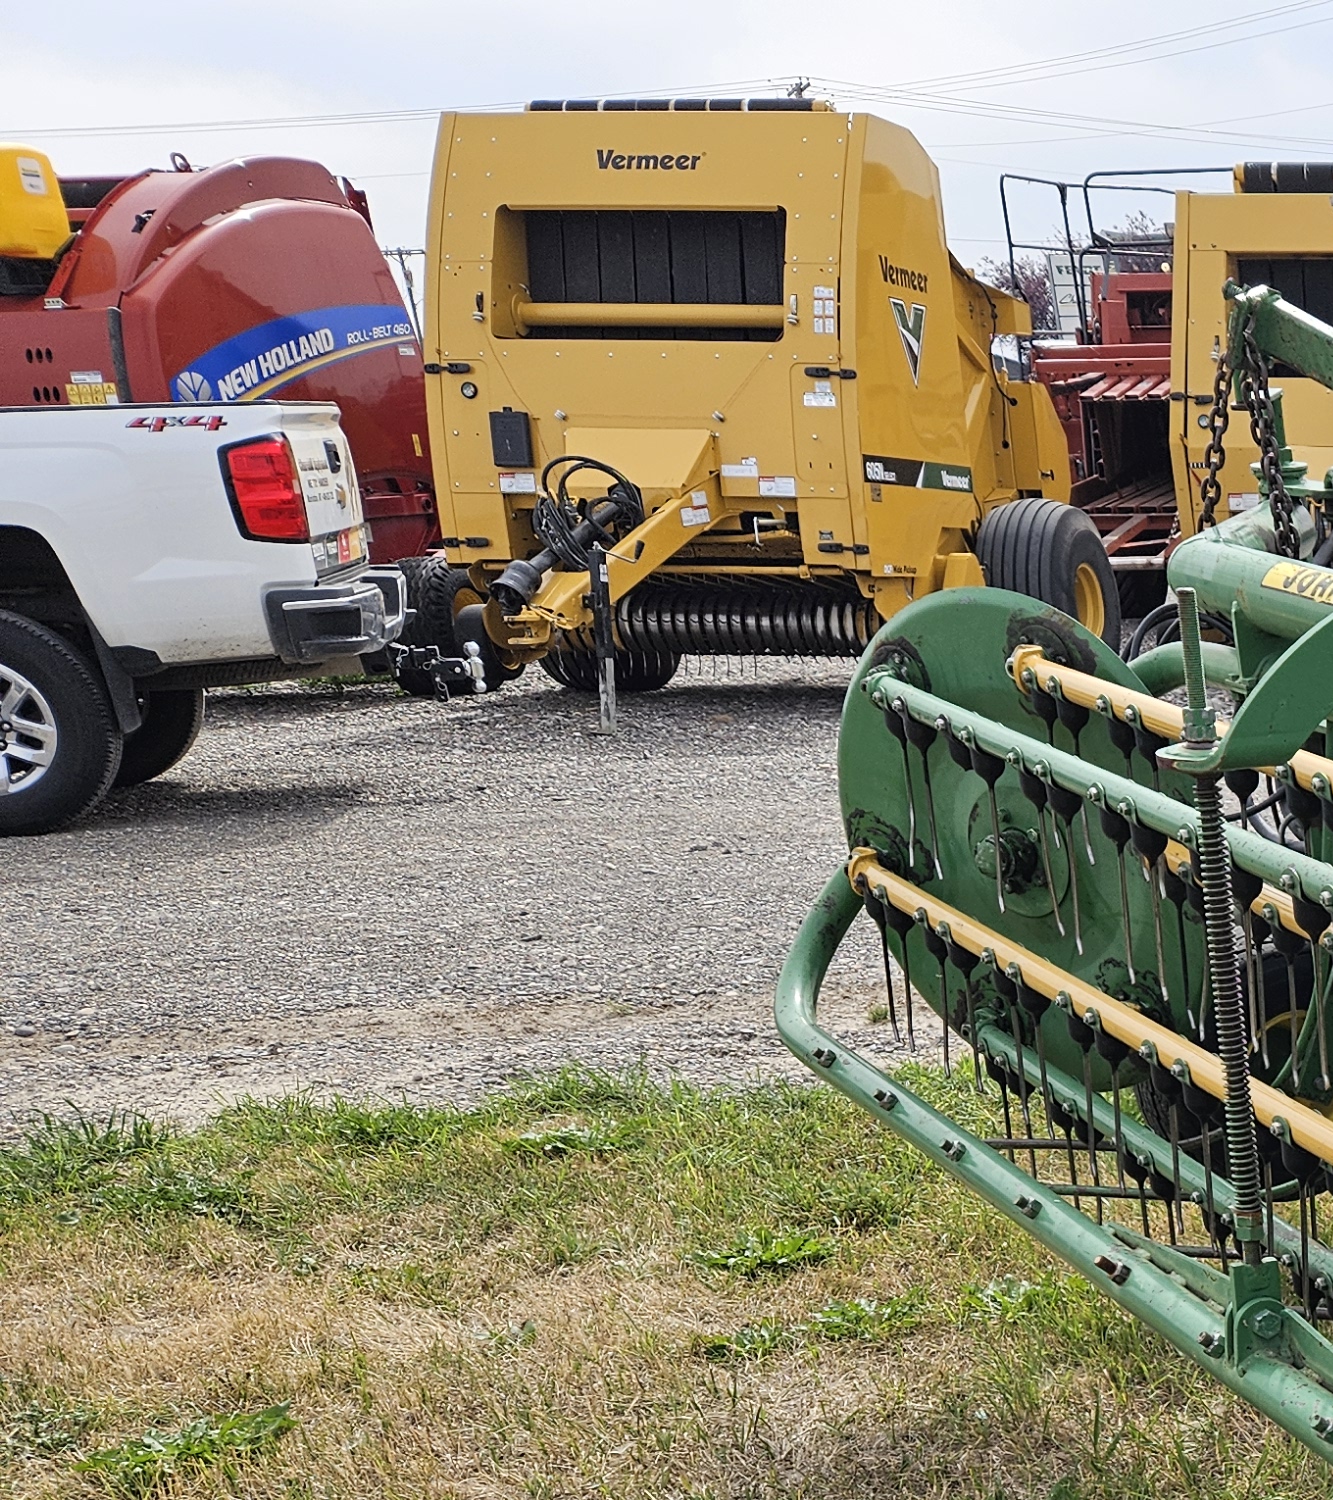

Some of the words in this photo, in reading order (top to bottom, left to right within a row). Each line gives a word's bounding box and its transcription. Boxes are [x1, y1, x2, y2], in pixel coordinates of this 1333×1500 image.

[596, 149, 701, 170] Vermeer
[878, 254, 928, 294] Vermeer
[346, 326, 391, 346] ROLL-BELT
[217, 358, 258, 400] NEW
[259, 328, 335, 379] HOLLAND
